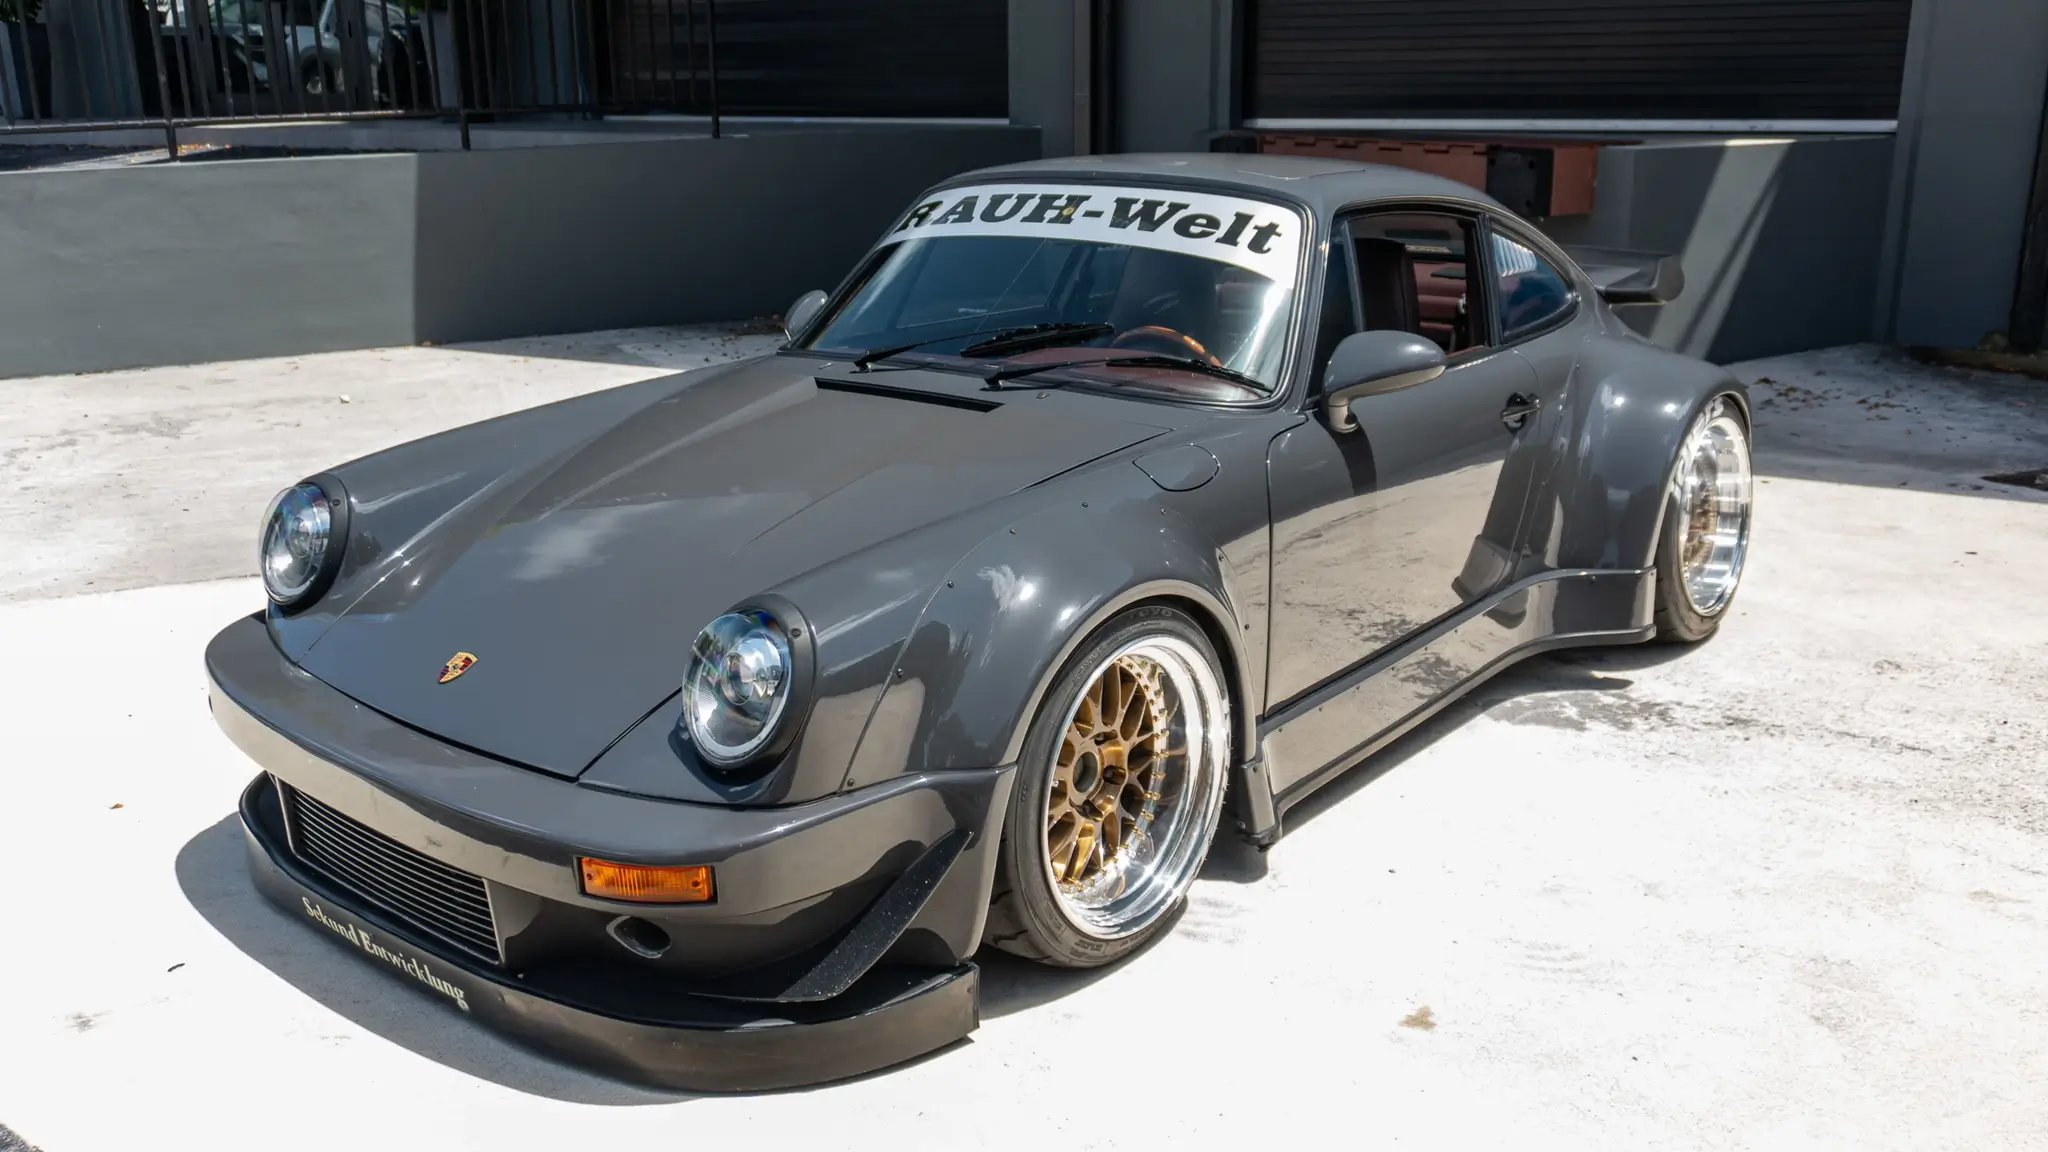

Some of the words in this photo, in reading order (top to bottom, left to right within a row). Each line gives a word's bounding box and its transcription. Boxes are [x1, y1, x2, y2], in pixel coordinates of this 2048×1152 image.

[893, 193, 1283, 255] RAUH-Welt
[302, 896, 361, 948] Sekund
[357, 928, 470, 1012] Entwicklung
